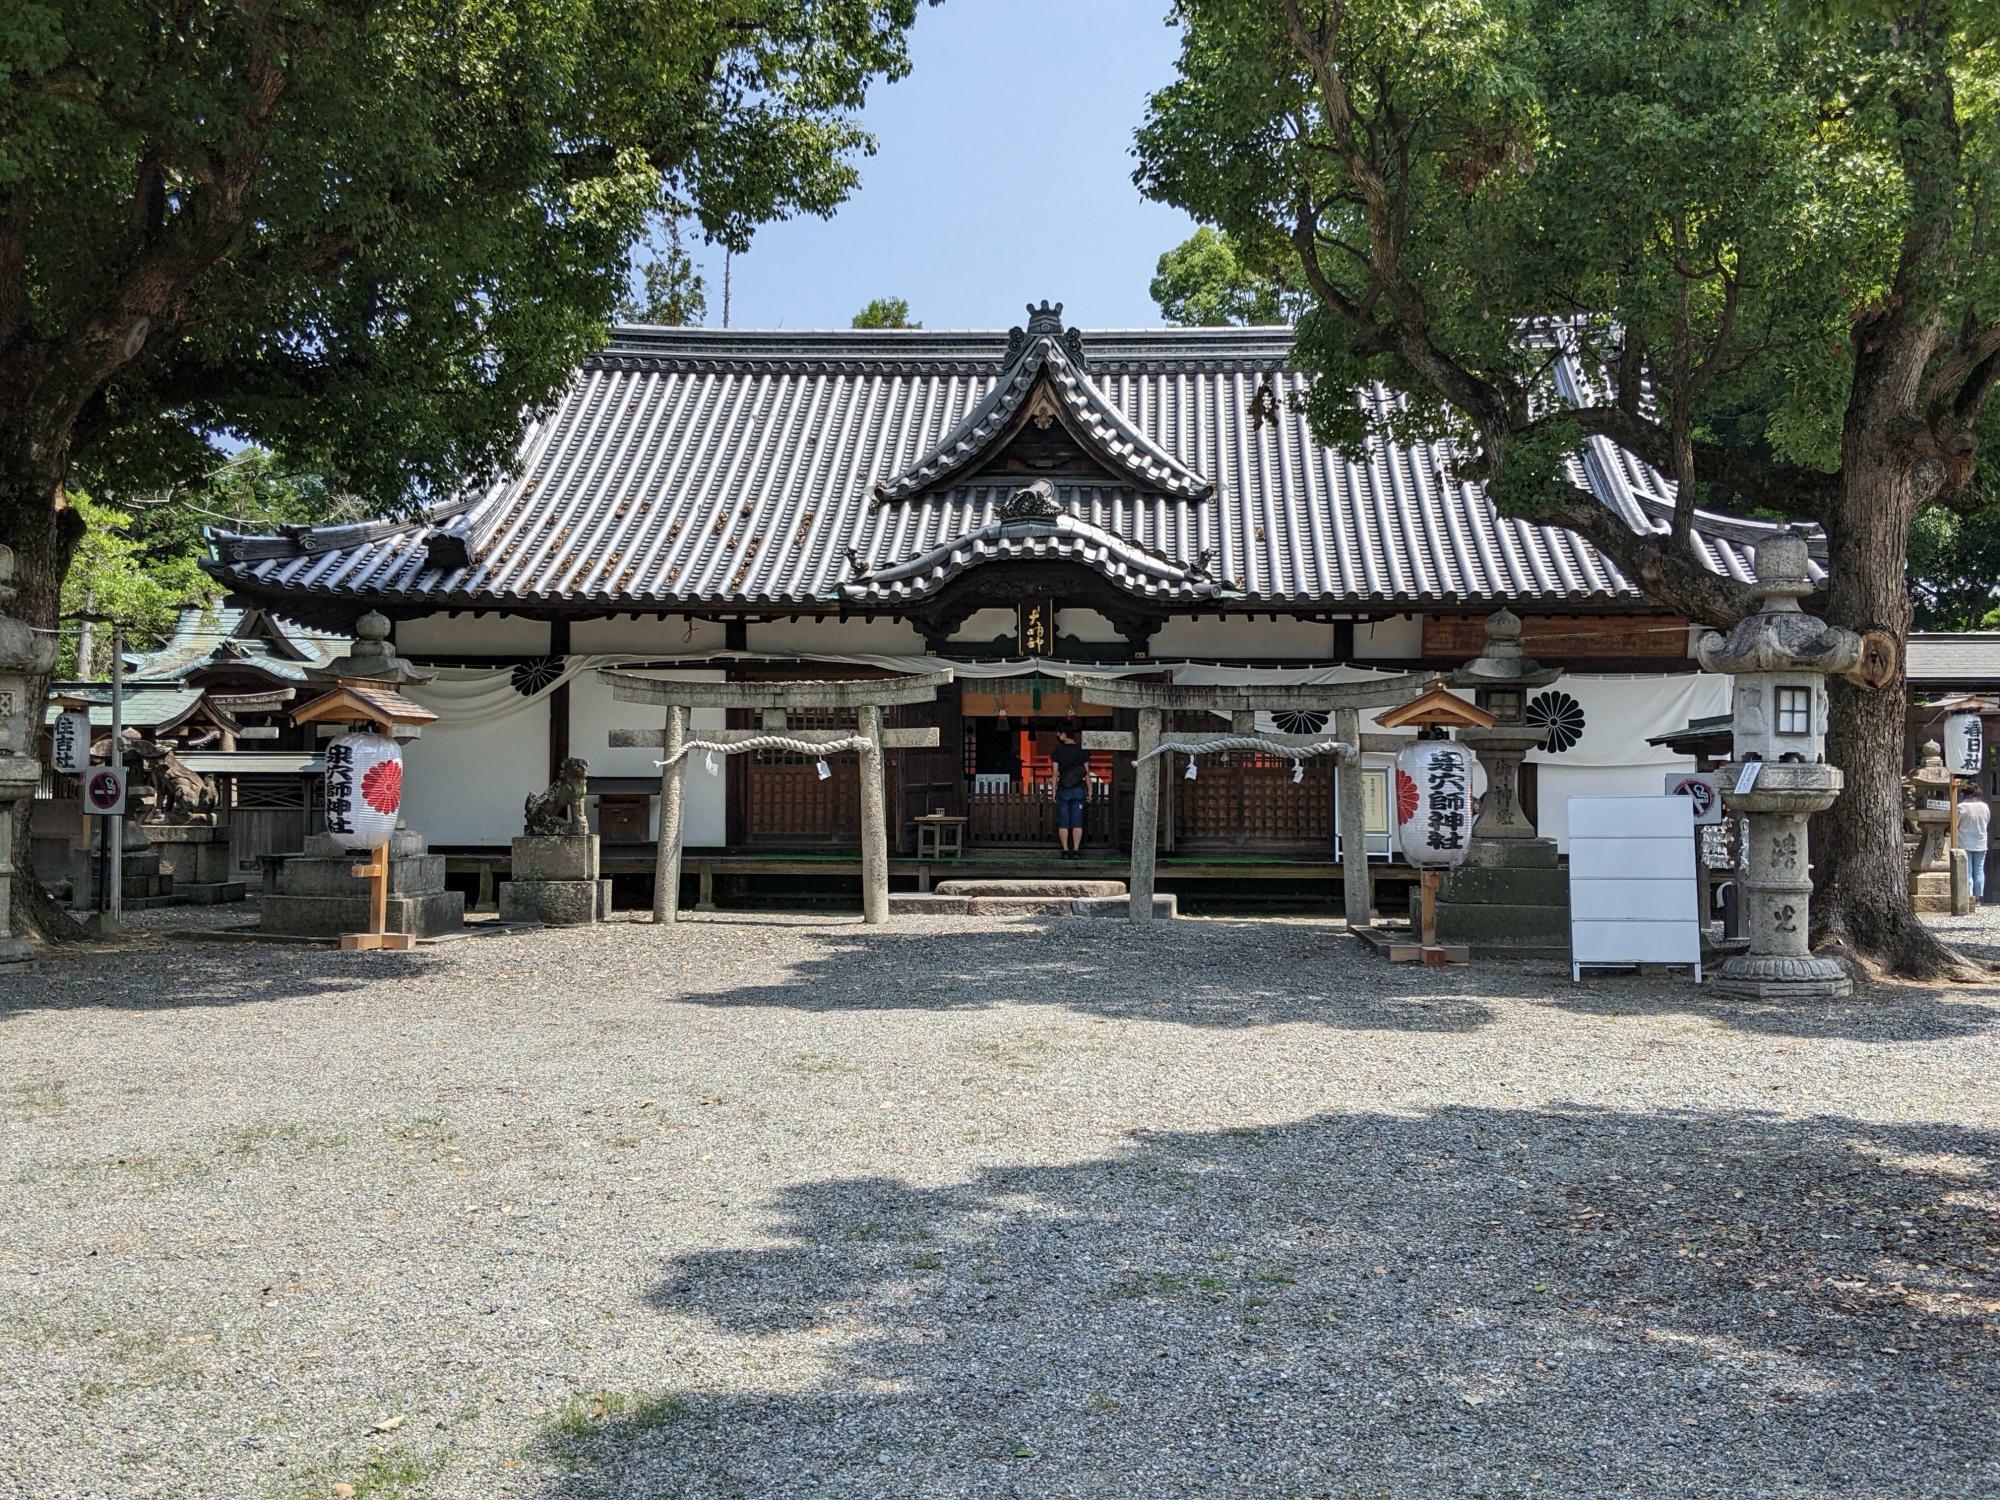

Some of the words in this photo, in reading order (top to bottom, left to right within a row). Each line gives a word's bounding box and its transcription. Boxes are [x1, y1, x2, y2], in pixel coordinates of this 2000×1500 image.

[55, 716, 75, 768] 住吉社
[1960, 720, 1982, 770] 春日社
[326, 744, 354, 834] 泉穴師神社
[1426, 751, 1465, 850] 泉穴師神社
